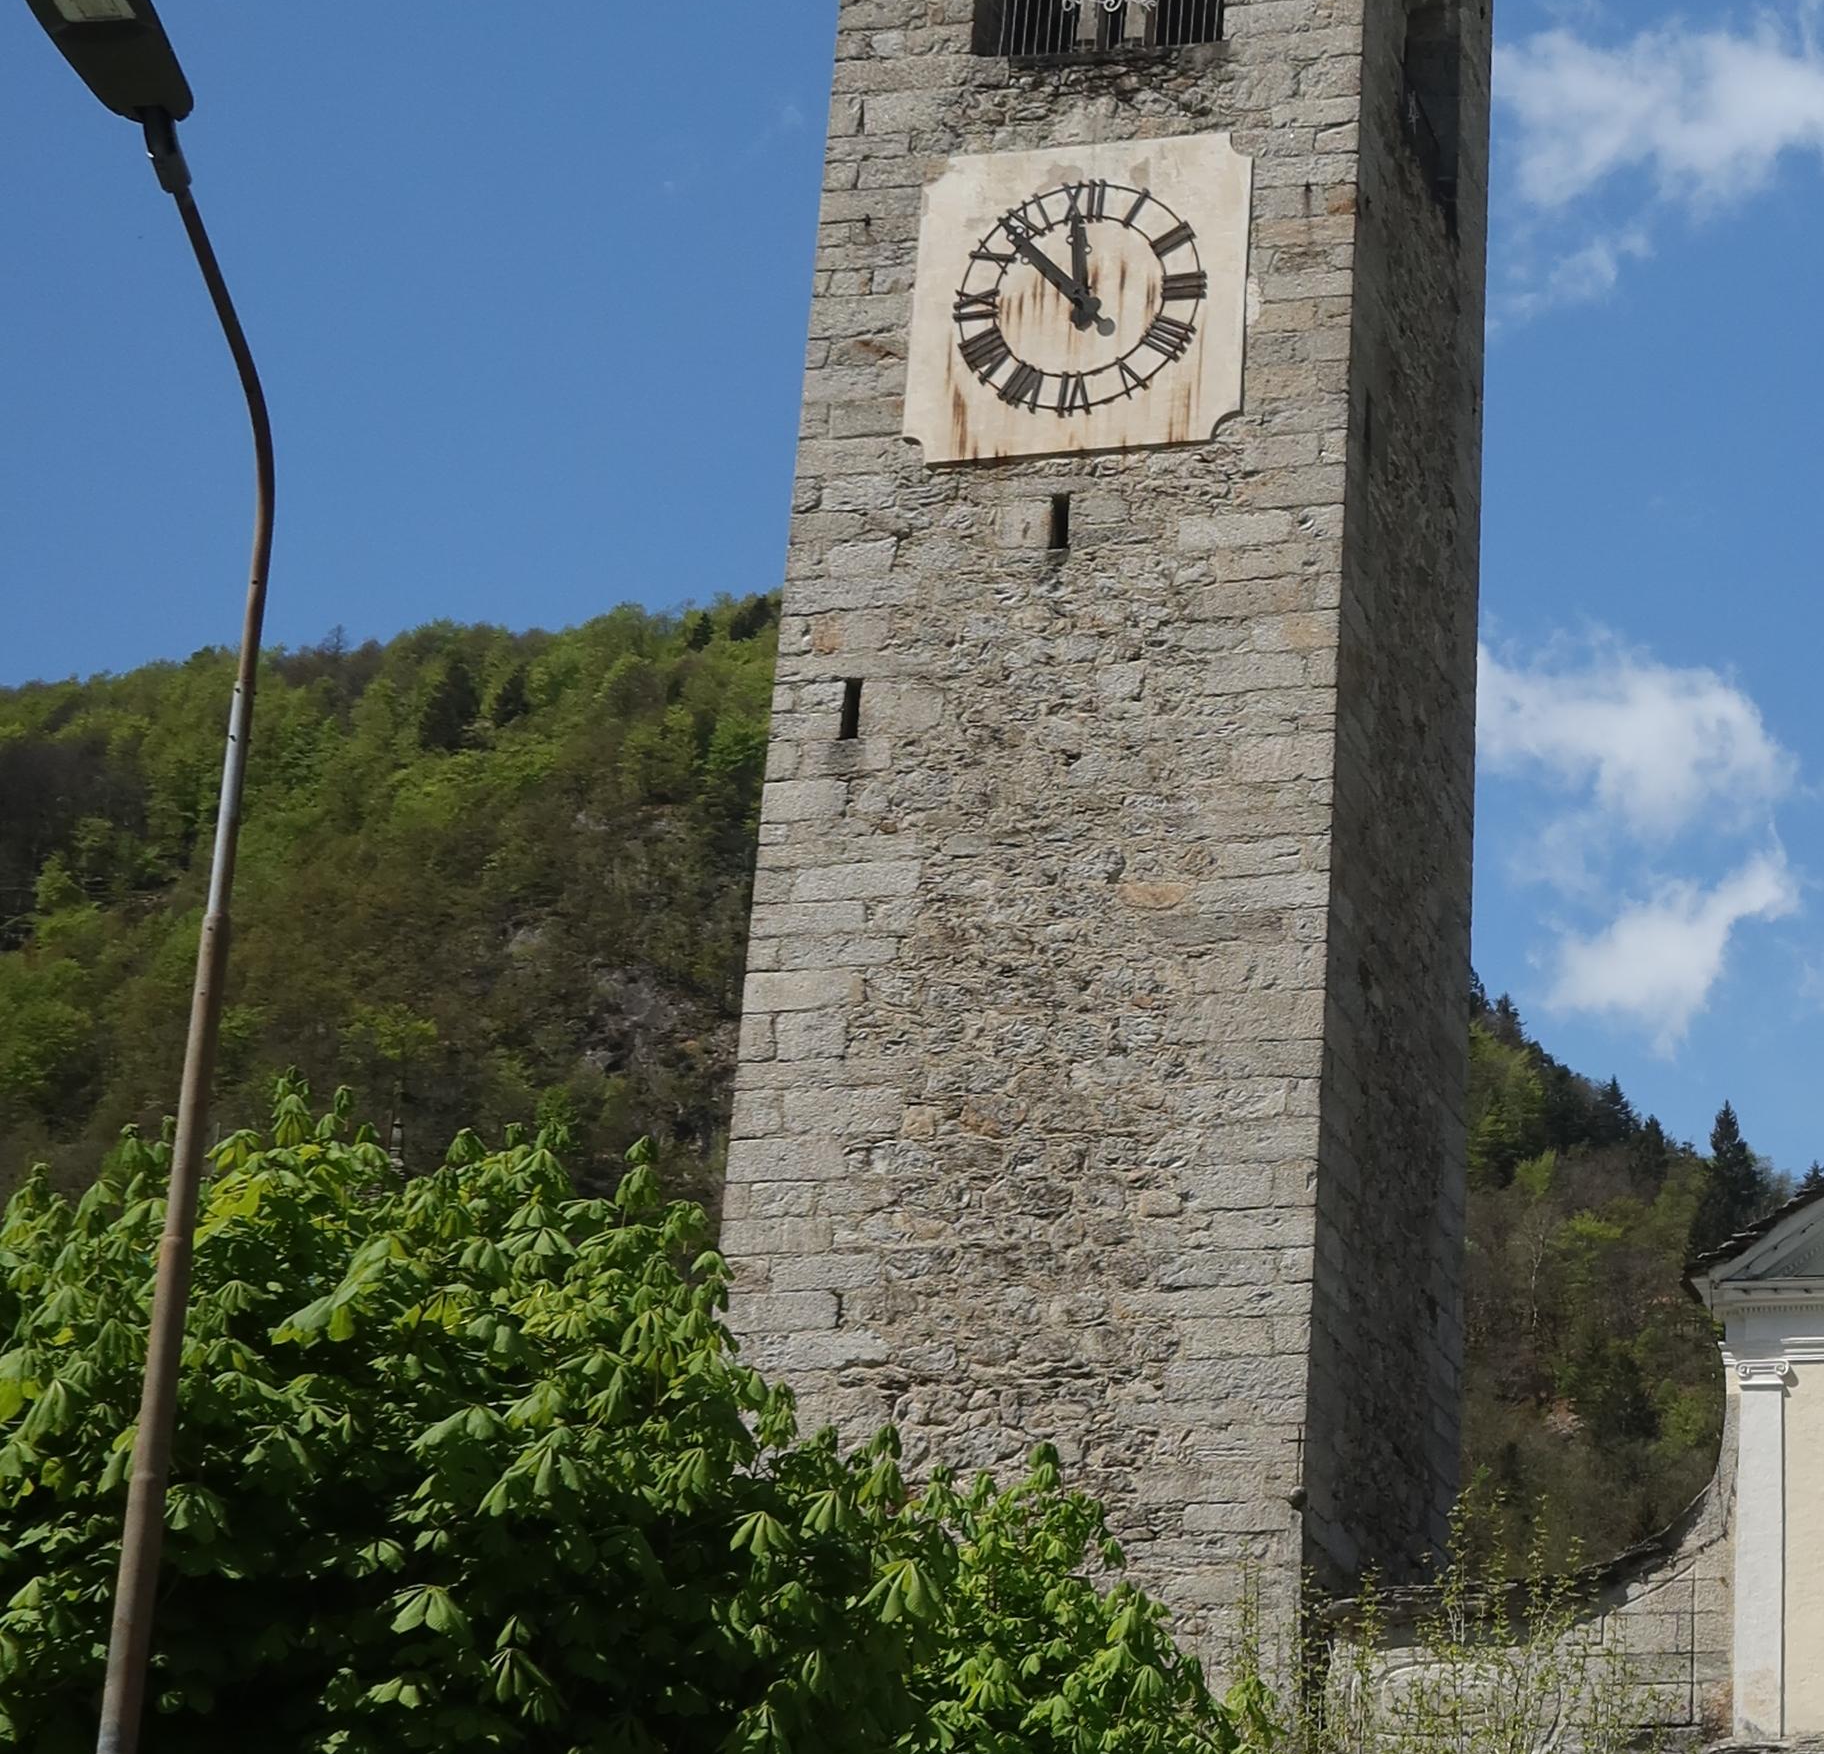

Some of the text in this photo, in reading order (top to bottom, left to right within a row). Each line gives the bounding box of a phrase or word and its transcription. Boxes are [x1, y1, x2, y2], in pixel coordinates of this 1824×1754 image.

[1062, 178, 1108, 226] XII
[1149, 219, 1197, 259] II
[1161, 269, 1208, 301] III
